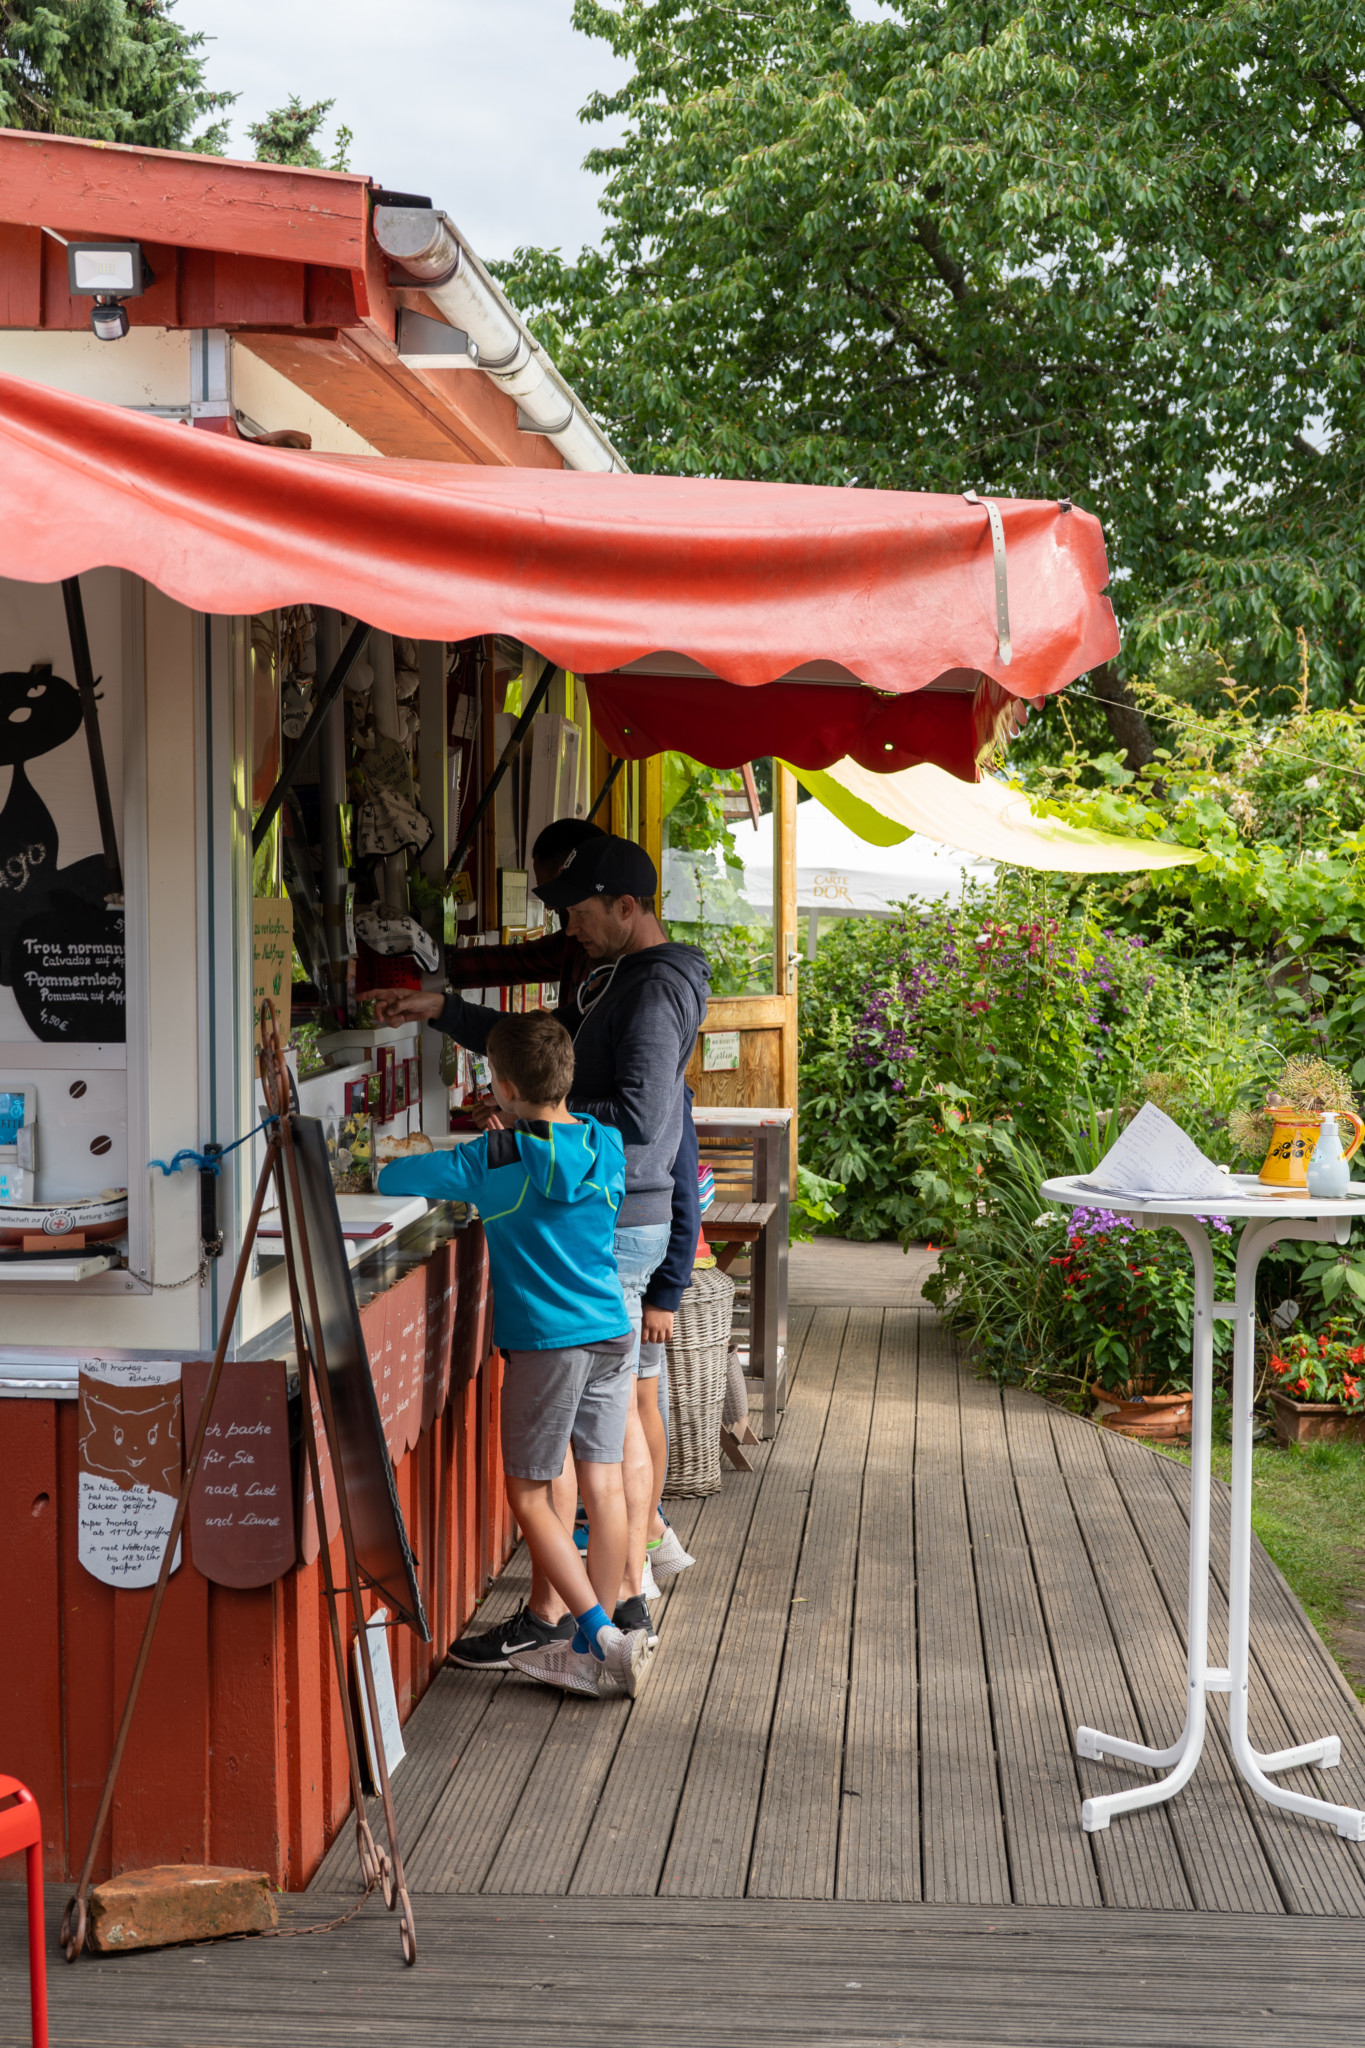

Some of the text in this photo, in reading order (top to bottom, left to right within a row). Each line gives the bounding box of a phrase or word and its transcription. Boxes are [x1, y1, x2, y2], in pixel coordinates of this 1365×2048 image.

[813, 874, 848, 885] CARTE
[23, 939, 126, 954] Trou norman
[42, 956, 91, 967] Calvados
[95, 956, 109, 968] auf
[24, 971, 122, 989] Pommernloch
[40, 987, 89, 1002] Pommeau
[90, 990, 105, 1004] auf
[40, 1008, 69, 1031] 4,50€
[79, 1213, 102, 1221] Rettung
[205, 1421, 271, 1439] ch backe
[203, 1449, 256, 1470] für Sie
[205, 1481, 278, 1497] nach Lust
[88, 1501, 156, 1514] Oktober geöffnet
[105, 1517, 138, 1531] Montag
[205, 1512, 280, 1526] und Laune
[144, 1526, 170, 1539] geöffne
[122, 1543, 160, 1554] Wetterlage
[146, 1553, 160, 1561] Uhr
